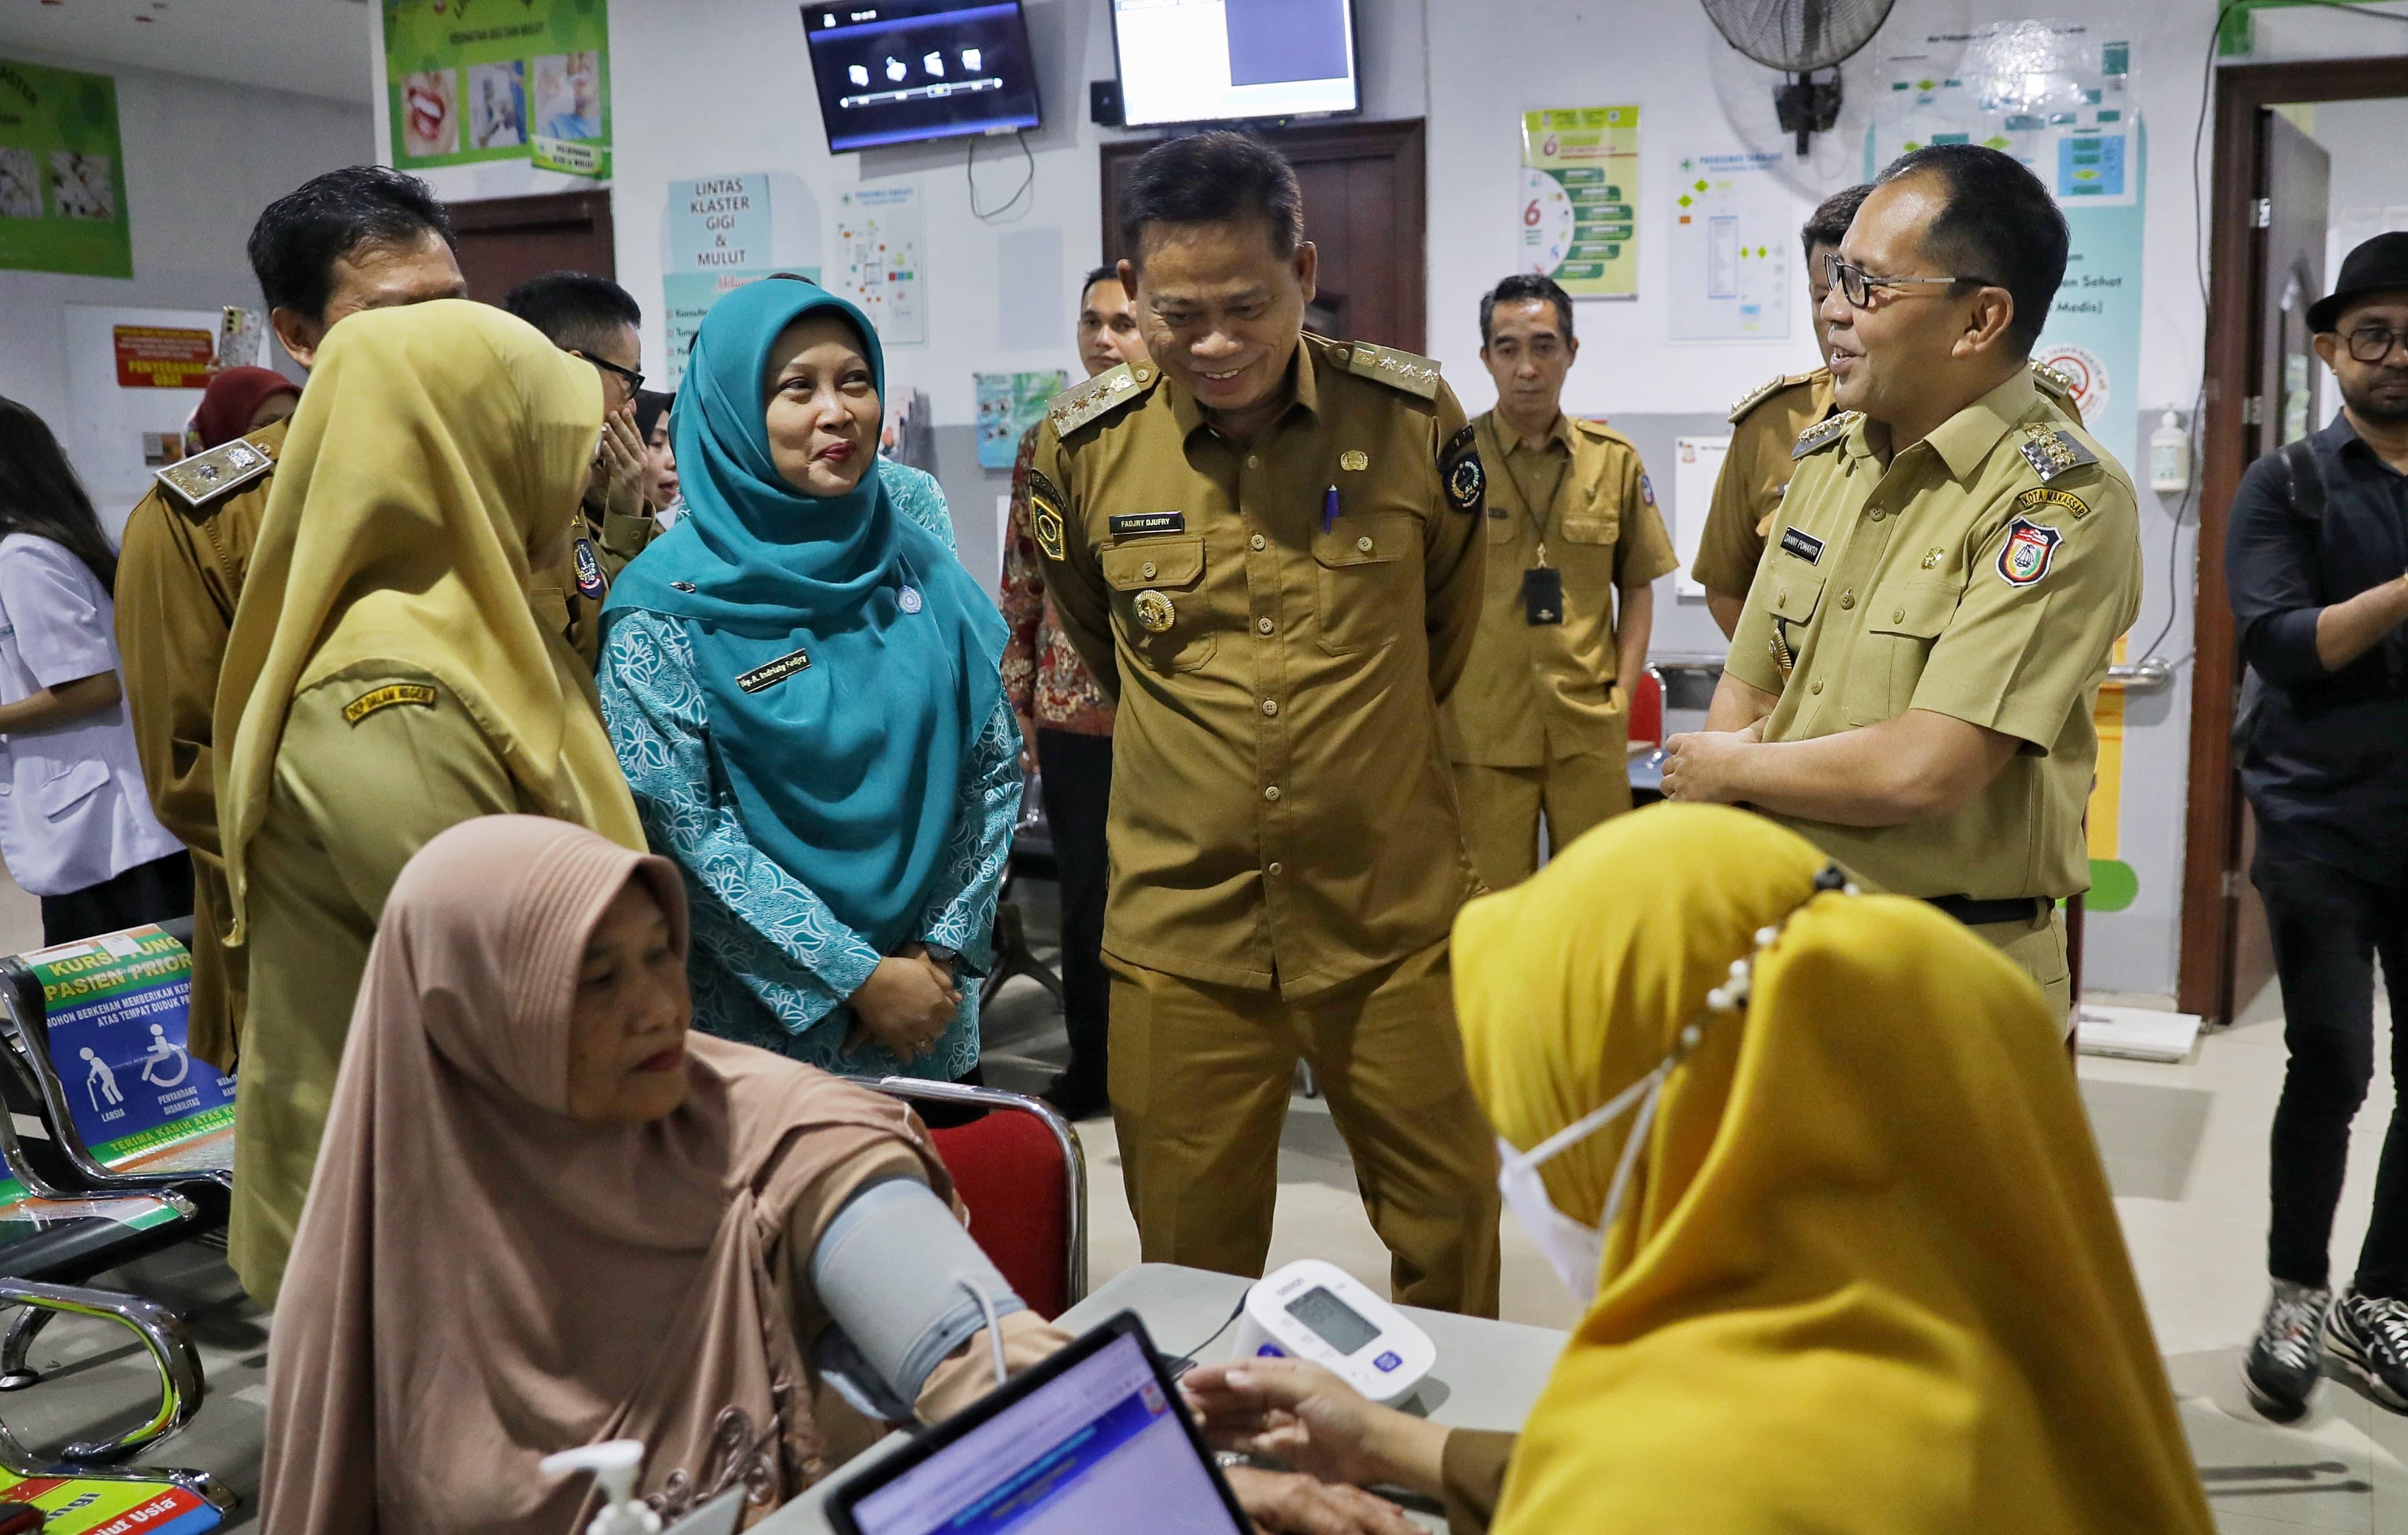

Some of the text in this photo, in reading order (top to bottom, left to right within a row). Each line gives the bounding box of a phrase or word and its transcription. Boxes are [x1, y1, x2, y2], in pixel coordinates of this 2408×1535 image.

[1543, 133, 1557, 156] 6
[695, 179, 743, 196] LINTAS
[690, 196, 750, 214] KLASTER
[1525, 199, 1541, 227] 6
[706, 215, 735, 230] GIGI
[715, 234, 727, 247] &
[697, 249, 745, 266] MULUT
[2084, 275, 2121, 287] Sehat
[2022, 490, 2085, 516] KOTA MAKASSAR
[1121, 518, 1170, 527] FADJRY DJUFRY
[1783, 533, 1818, 556] DANNY POMANTO
[785, 656, 806, 667] Fadjry
[48, 952, 120, 977] KURS
[43, 968, 126, 1002] PASIEN
[76, 1000, 122, 1020] BERKENAN
[122, 988, 173, 1010] MEMBERIKAN
[97, 1013, 119, 1027] ATAS
[119, 1005, 151, 1022] TEMPAT
[151, 997, 181, 1013] DUDUK
[157, 1086, 198, 1105] PENYANDANG
[101, 1108, 126, 1122] LANSIA
[163, 1097, 201, 1115] DISABILITAS
[110, 1132, 154, 1151] TERIMA
[156, 1119, 192, 1137] KASIH
[193, 1110, 223, 1126] ATAS
[129, 1496, 178, 1522] Usia
